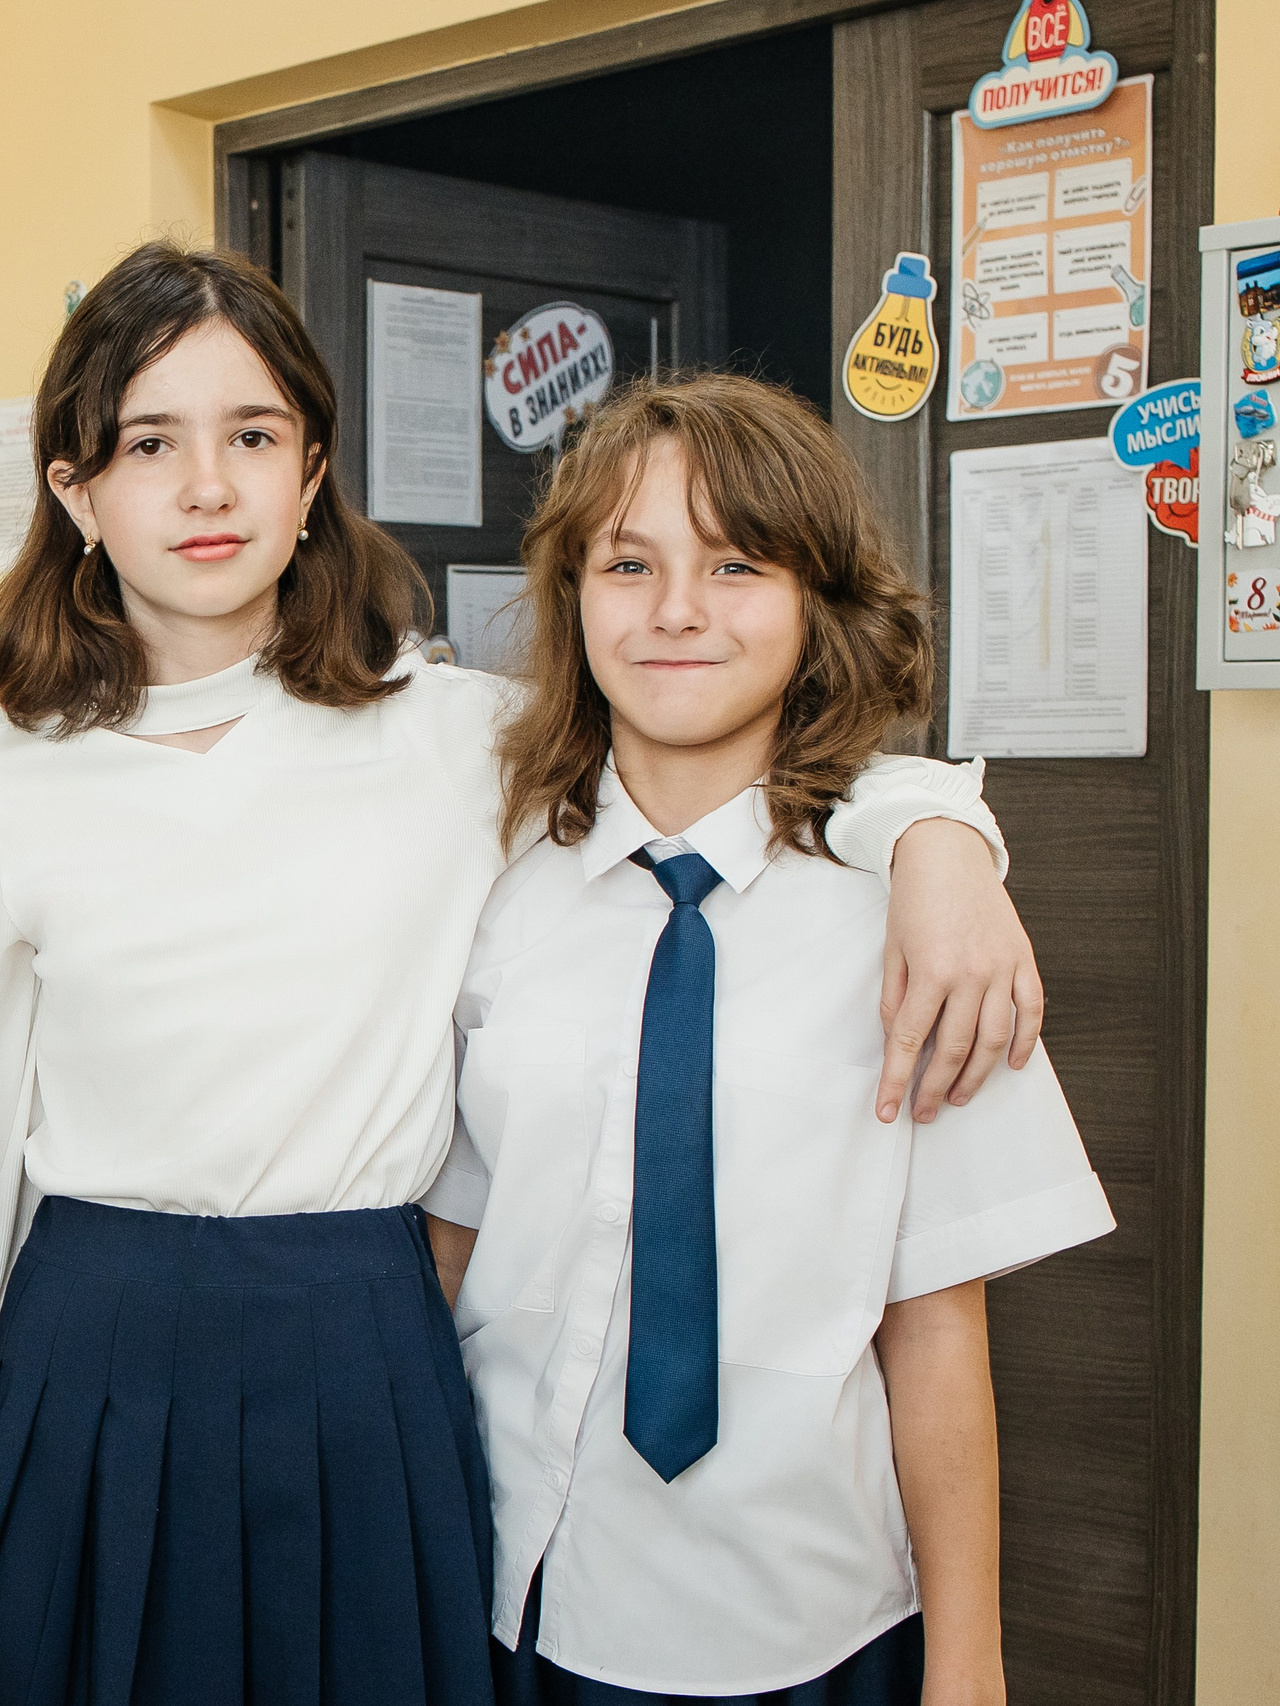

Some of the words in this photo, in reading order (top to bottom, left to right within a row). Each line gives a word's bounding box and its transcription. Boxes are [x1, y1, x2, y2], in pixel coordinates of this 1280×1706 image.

[1026, 4, 1069, 52] ВСЁ
[981, 66, 1106, 114] ПОЛУЧИТСЯ!
[1036, 126, 1107, 150] получить
[502, 320, 588, 395] СИЛА-
[873, 322, 924, 358] БУДЬ
[508, 406, 524, 439] В
[524, 343, 610, 428] ЗНАНИЯХ!
[851, 352, 929, 385] АКТИВНЫМ!
[1100, 350, 1141, 400] 5
[1246, 576, 1268, 611] 8
